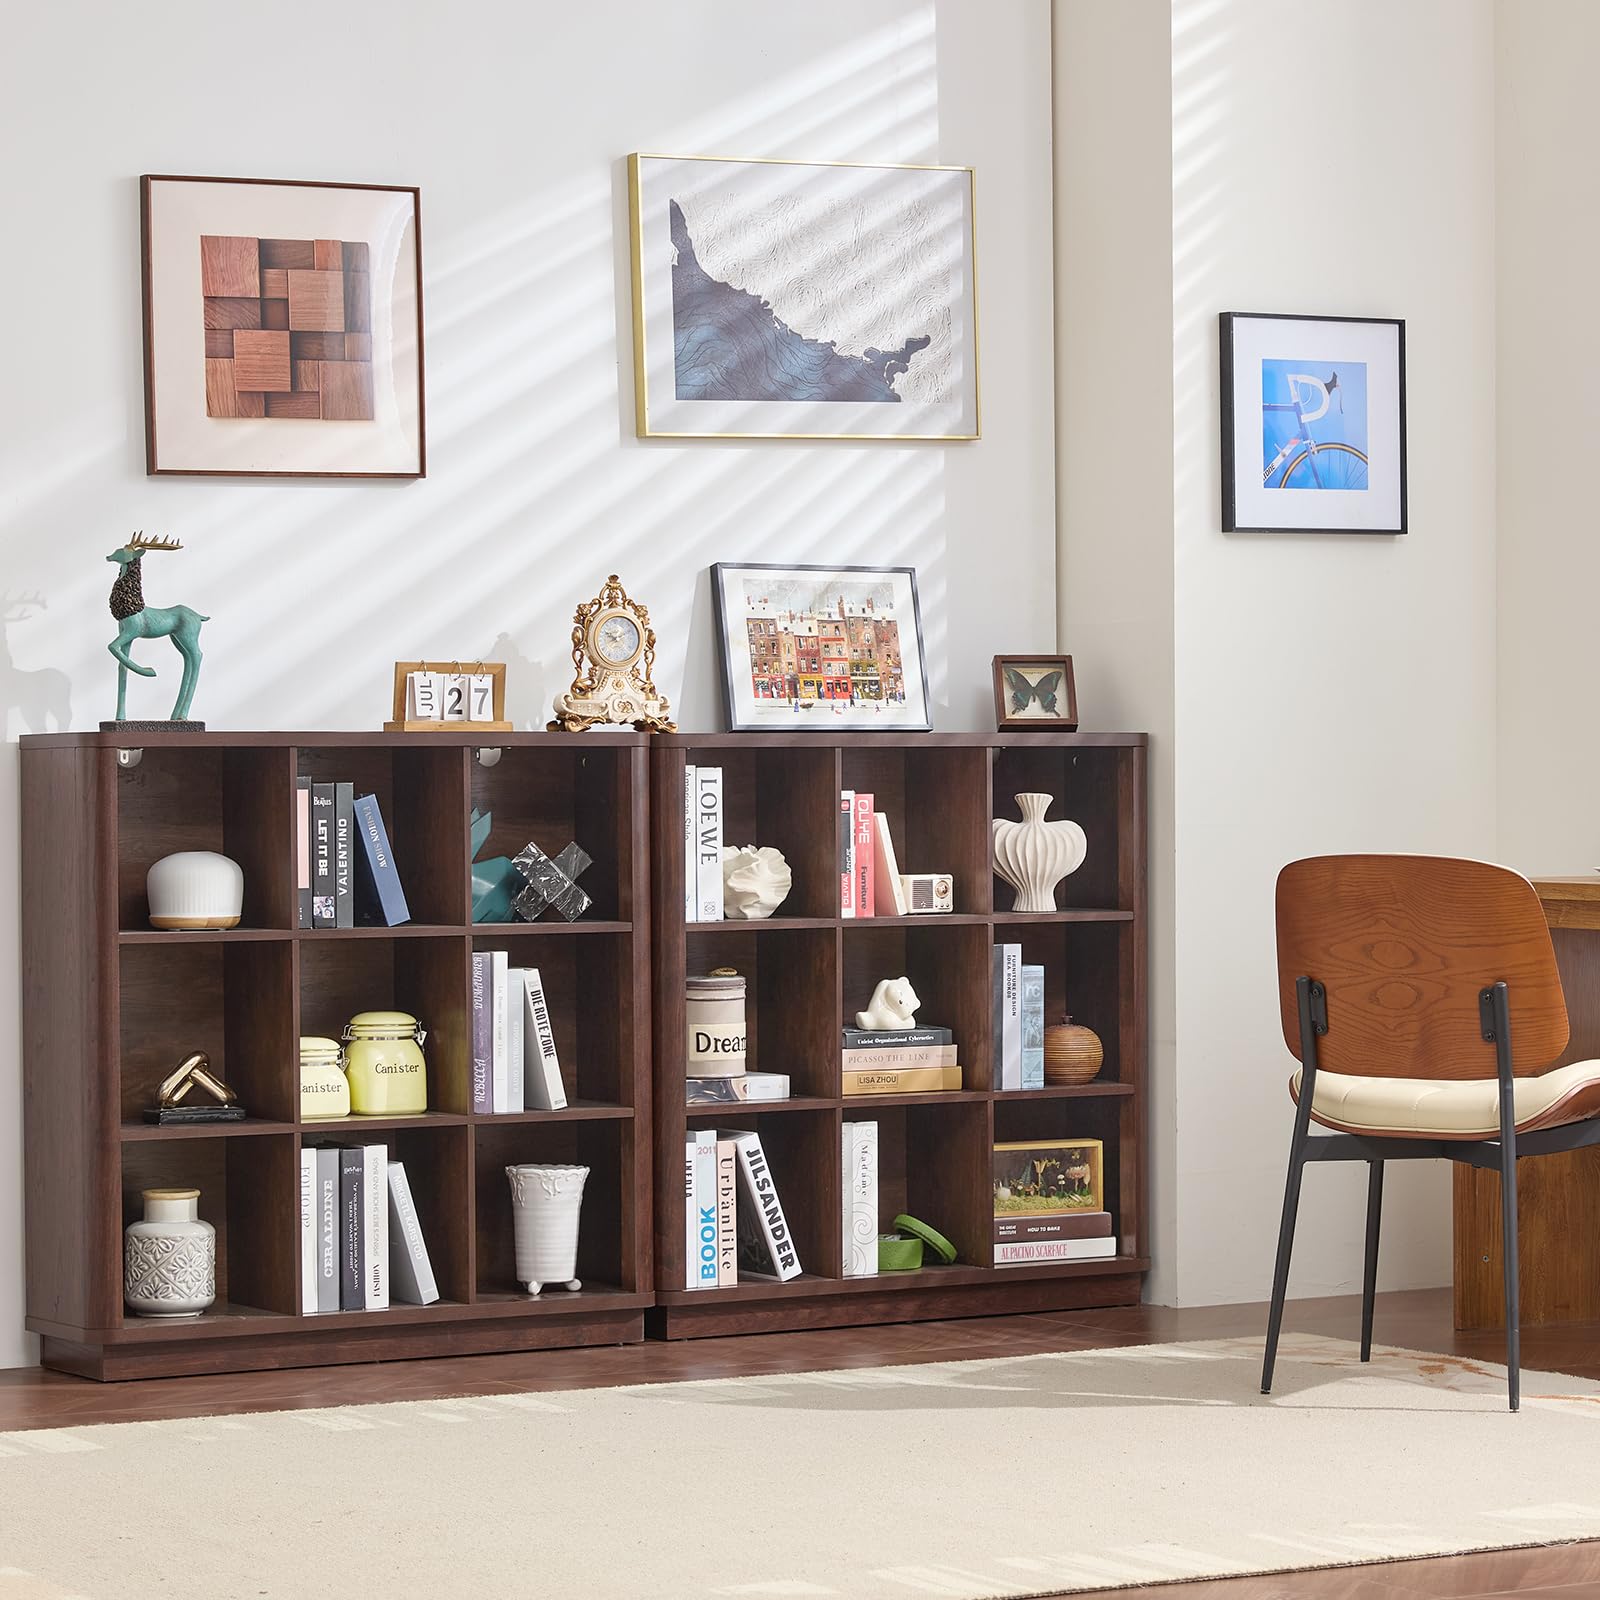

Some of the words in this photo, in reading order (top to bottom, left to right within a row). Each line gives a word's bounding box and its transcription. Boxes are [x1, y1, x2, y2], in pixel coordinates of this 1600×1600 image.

[420, 680, 433, 711] JUL
[317, 819, 328, 842] LET
[700, 779, 718, 865] LOEWE
[363, 806, 379, 843] FASHION
[371, 843, 388, 869] SHOW
[317, 844, 328, 857] IT
[338, 818, 348, 896] VALENTINO
[318, 859, 328, 876] BE
[530, 989, 542, 1007] DIE
[534, 1006, 549, 1033] ROTE
[540, 1032, 556, 1060] ZONE
[848, 1055, 884, 1064] PICASSO
[886, 1054, 904, 1062] THE
[908, 1053, 929, 1061] LINE
[375, 1063, 419, 1074] Canister
[474, 1058, 486, 1103] REBECCA
[859, 1076, 876, 1084] LISA
[876, 1075, 897, 1083] ZHOU
[700, 1206, 716, 1280] BOOK
[1001, 1247, 1009, 1260] AL
[1010, 1245, 1035, 1260] PACINO
[1035, 1244, 1067, 1258] SCARFACE
